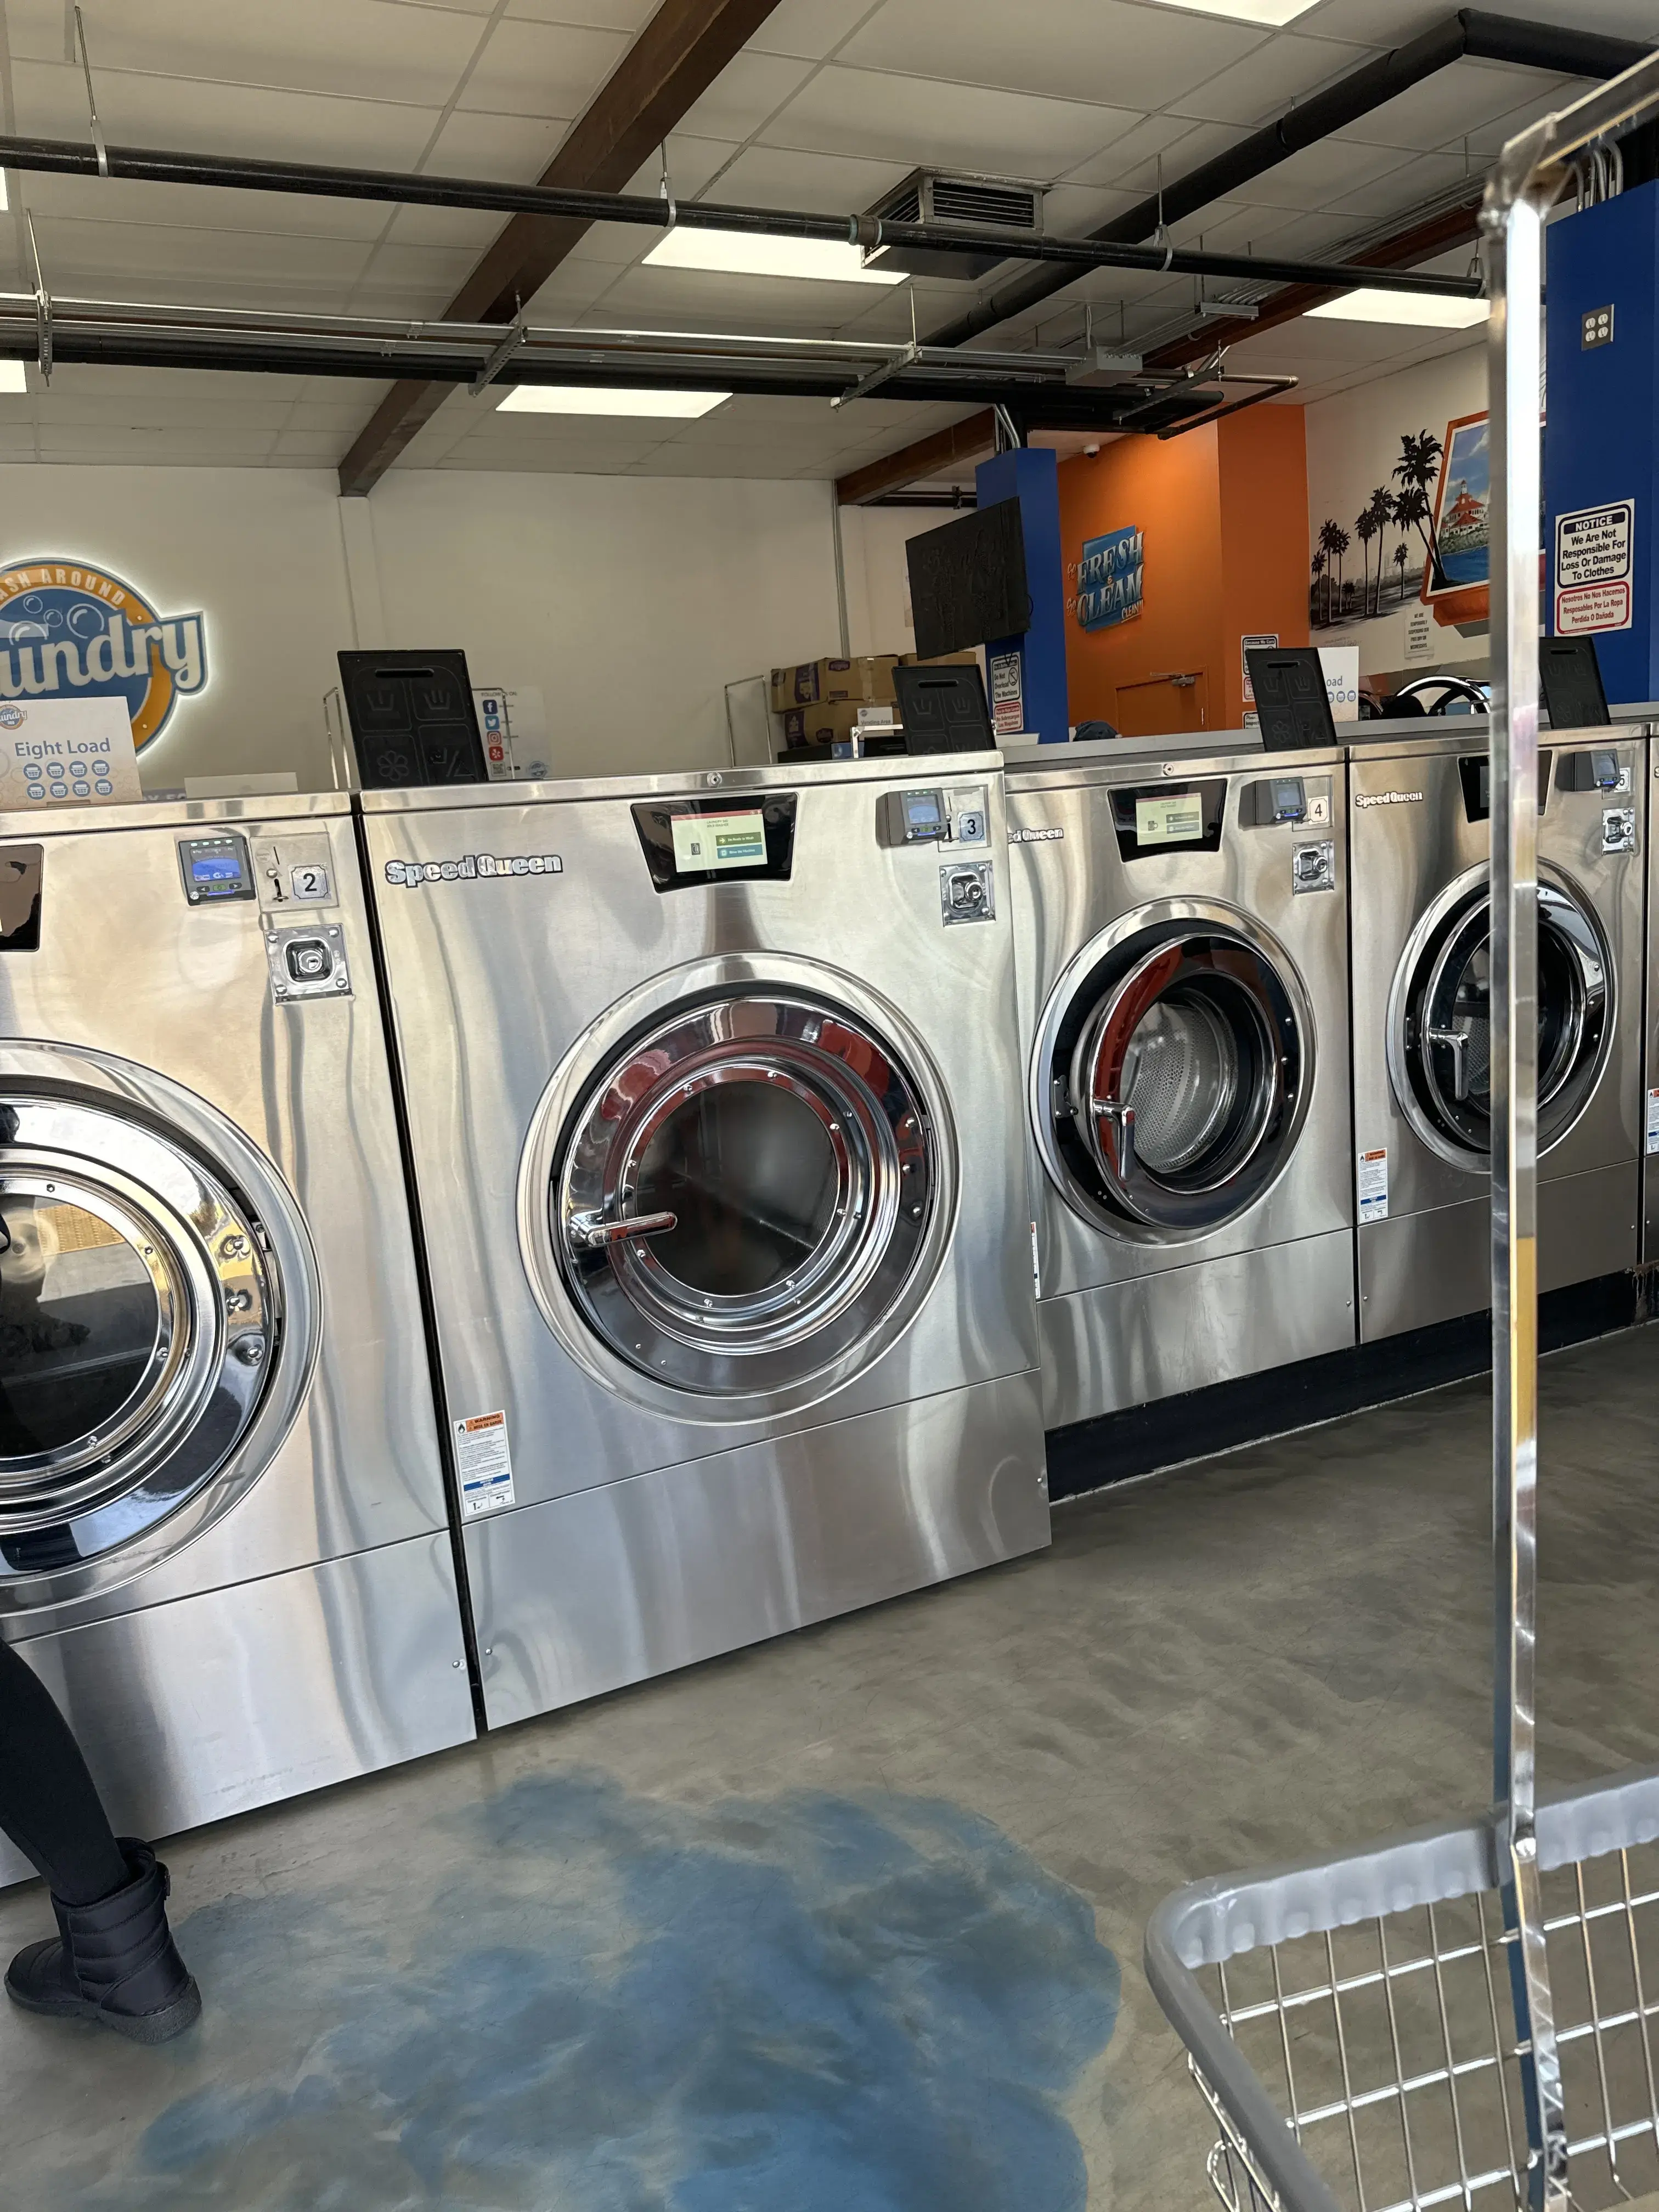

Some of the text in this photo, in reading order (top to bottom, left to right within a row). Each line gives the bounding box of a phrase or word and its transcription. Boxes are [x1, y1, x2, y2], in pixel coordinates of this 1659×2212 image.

[1575, 515, 1613, 532] NOTICE
[1571, 528, 1616, 546] We Are Not
[1562, 540, 1626, 559] Responsible For
[1076, 531, 1144, 595] FRESH
[1561, 552, 1627, 571] Loss Or Damage
[1572, 566, 1615, 580] To Clothes
[42, 568, 125, 605] AROUND
[1076, 563, 1144, 626] CLEAN
[1562, 595, 1583, 604] Nosotros
[1602, 588, 1626, 597] Hacemos
[1611, 599, 1623, 607] Ropa
[1572, 614, 1590, 624] Perdida
[1595, 611, 1614, 620] Dañada
[0, 614, 200, 697] undry
[994, 680, 1009, 690] Overload
[1326, 675, 1343, 686] oad
[1002, 689, 1018, 697] Machines
[0, 711, 26, 721] undry
[15, 737, 111, 759] Eight Load
[1620, 774, 1625, 786] 5
[1355, 791, 1423, 809] Speed Queen
[1315, 804, 1323, 817] 4
[967, 819, 976, 835] 3
[1022, 828, 1064, 842] Queen
[385, 854, 563, 888] Speed Queen
[303, 873, 317, 892] 2
[474, 1414, 500, 1424] WARNING
